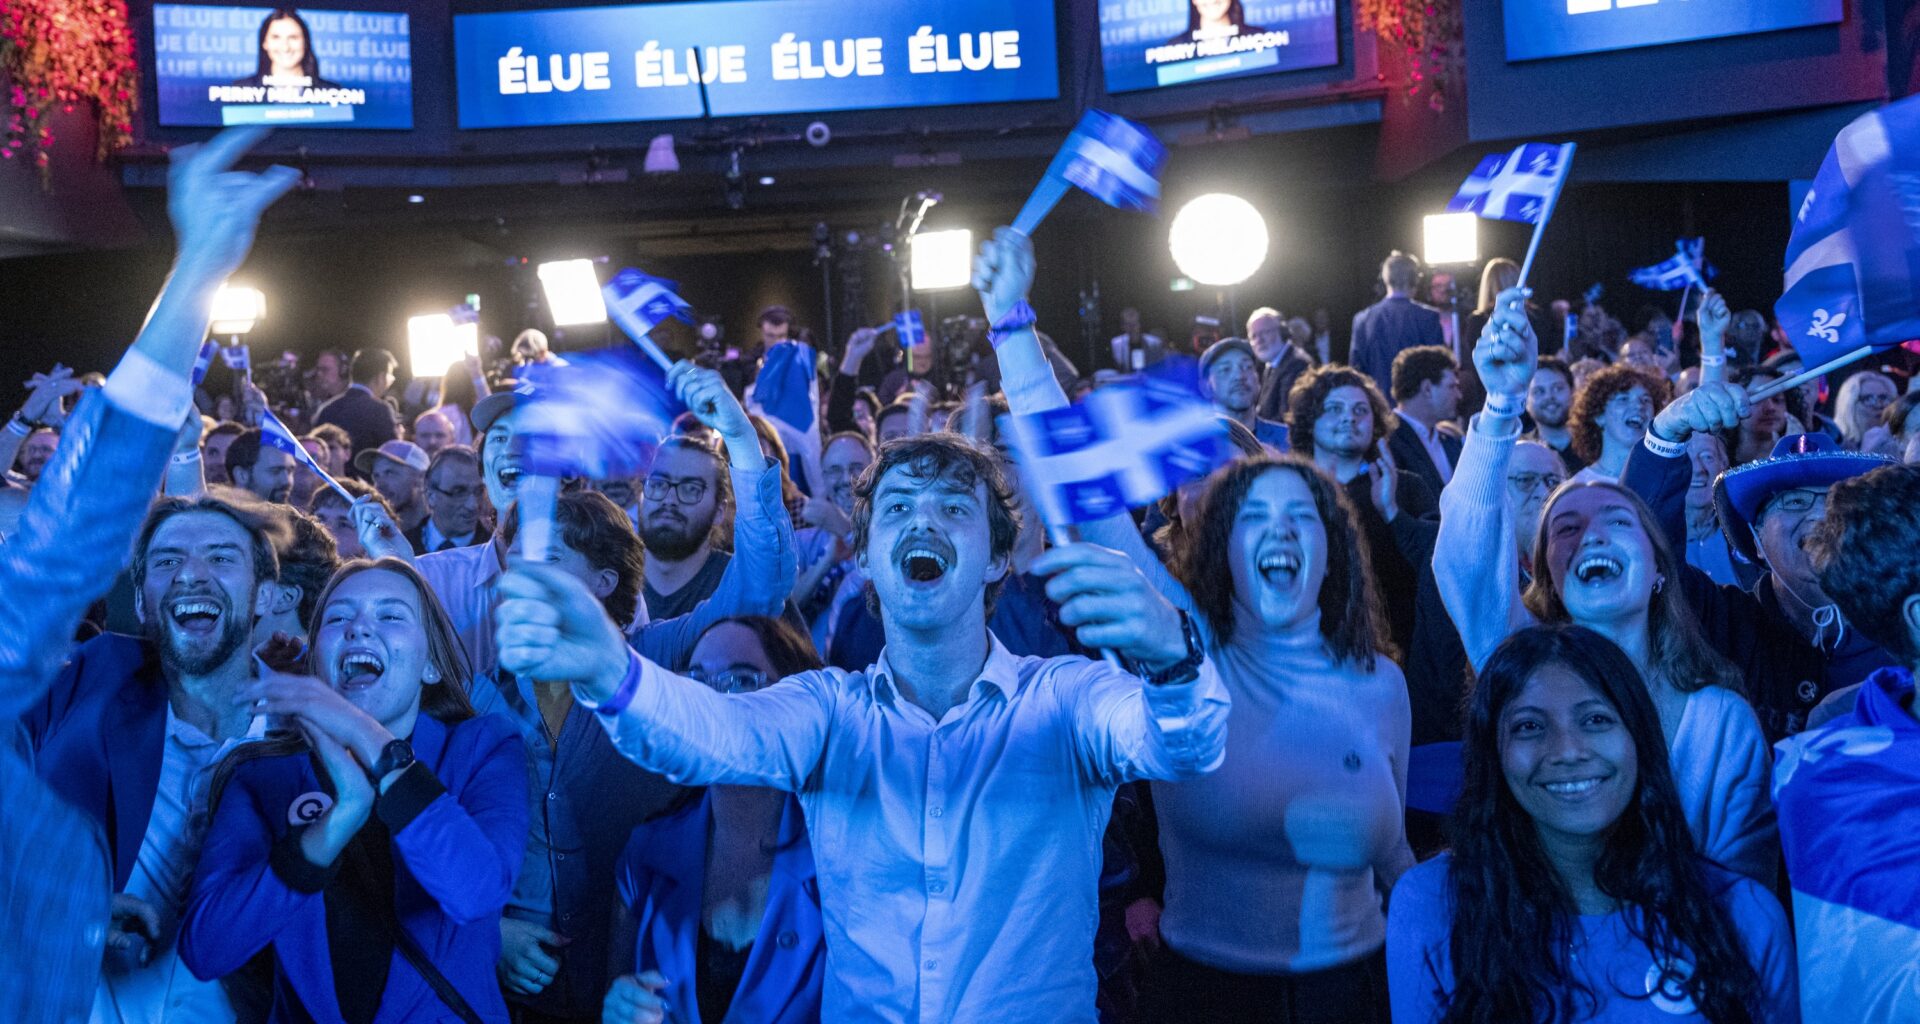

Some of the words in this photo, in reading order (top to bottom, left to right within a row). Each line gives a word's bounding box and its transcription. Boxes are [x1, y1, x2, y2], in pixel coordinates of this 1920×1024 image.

[343, 11, 396, 34] ÉLUE
[186, 31, 241, 54] ÉLUE
[498, 46, 611, 94] ÉLUE
[635, 40, 747, 87] ÉLUE
[771, 32, 884, 80] ÉLUE
[908, 25, 1021, 73] ÉLUE
[209, 86, 265, 102] PERRY
